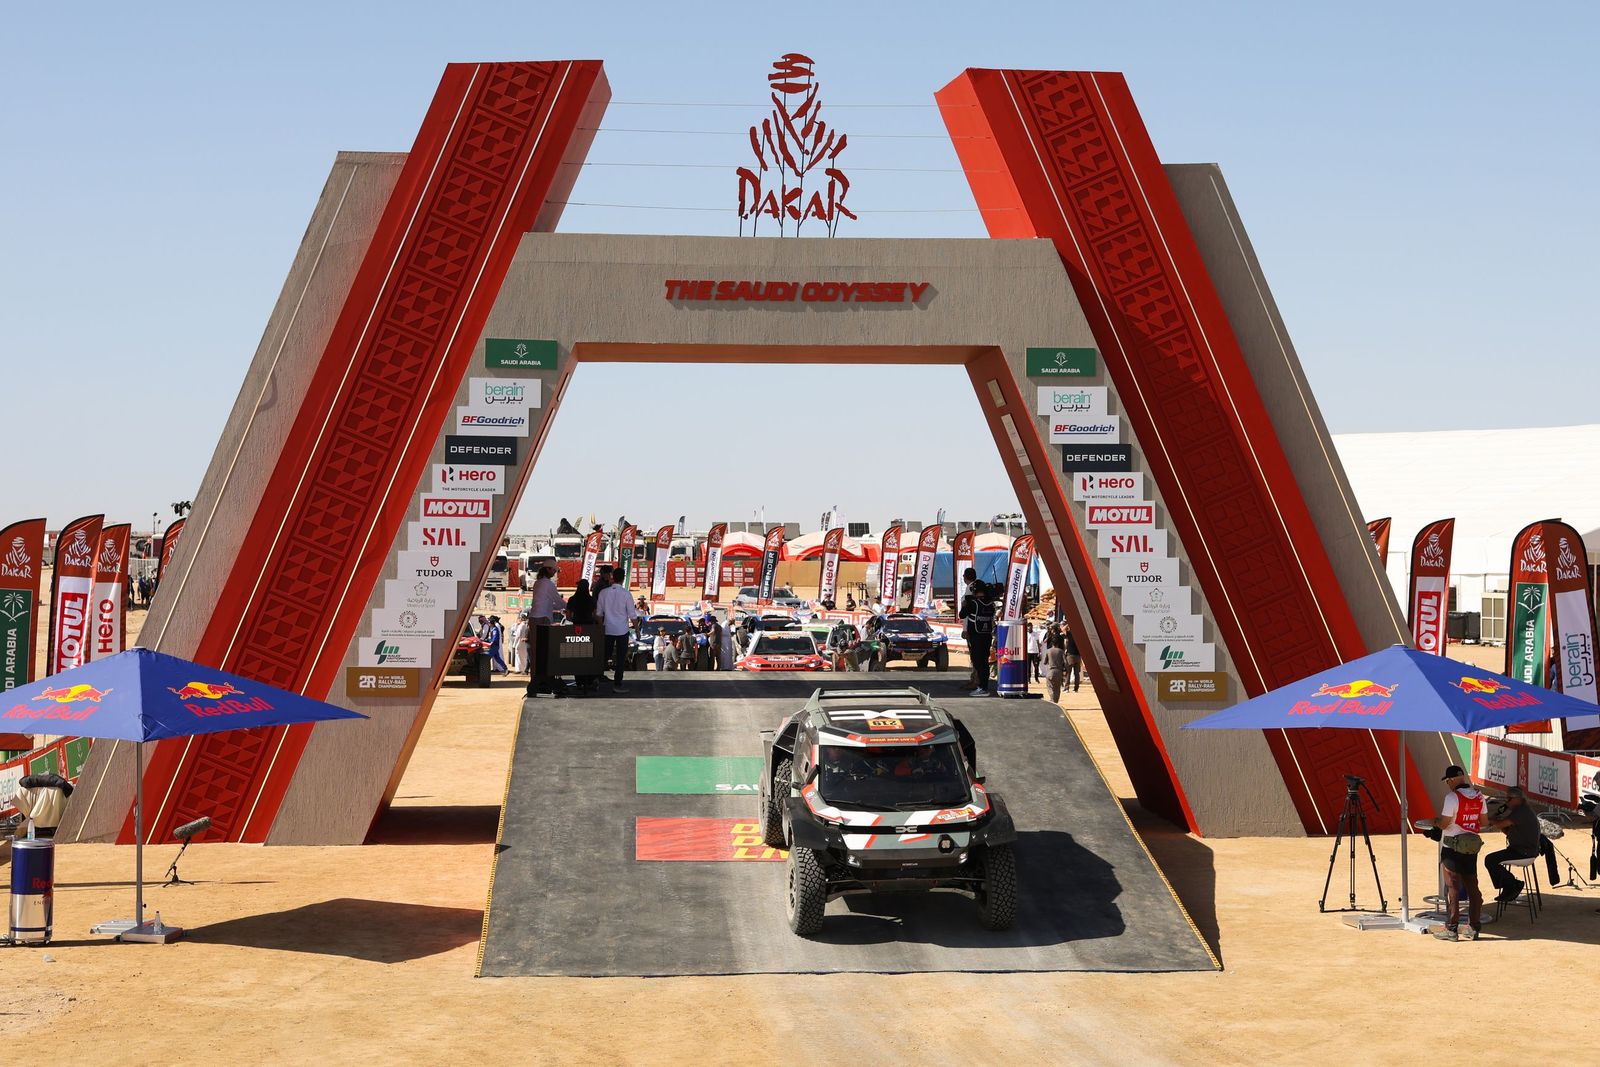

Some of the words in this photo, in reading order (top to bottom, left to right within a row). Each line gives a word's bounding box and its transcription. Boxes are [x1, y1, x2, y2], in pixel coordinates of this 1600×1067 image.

[736, 166, 857, 221] DAKAR
[665, 280, 715, 300] THE
[716, 281, 799, 302] SAUDI
[801, 282, 929, 302] ODYSSEY
[485, 382, 524, 396] berain
[1053, 390, 1091, 404] berain
[461, 415, 525, 425] BFGoodrich
[1054, 424, 1115, 432] BFGoodrich
[450, 445, 512, 455] DEFENDER
[1066, 454, 1126, 462] DEFENDER
[459, 470, 496, 481] Hero
[1098, 478, 1135, 489] Hero
[427, 501, 487, 515] MOTUL
[1091, 508, 1150, 522] MOTUL
[64, 553, 94, 568] DAKAR
[97, 562, 122, 573] DAKAR
[1420, 556, 1445, 568] DAKAR
[1520, 559, 1548, 573] DAKAR
[1, 563, 33, 579] DAKAR
[416, 569, 453, 577] TUDOR
[763, 552, 775, 598] DEFENDER
[825, 560, 834, 586] Hero
[1127, 575, 1162, 583] TUDOR
[1556, 566, 1582, 581] DAKAR
[885, 561, 895, 598] MOTUL
[919, 564, 929, 595] TUDOR
[1008, 568, 1021, 618] BFGoodrich
[98, 598, 114, 653] Hero
[1419, 594, 1438, 656] OTUL
[1524, 619, 1535, 660] ARABIA
[5, 628, 17, 674] ARABIA
[1562, 633, 1582, 688] berain
[2, 704, 56, 719] Red
[45, 704, 99, 720] Bull
[184, 700, 237, 717] Red
[225, 696, 275, 713] Bull
[1288, 699, 1343, 715] Red
[1338, 699, 1394, 716] Bull
[1488, 749, 1506, 771] berain
[1538, 760, 1559, 786] berain
